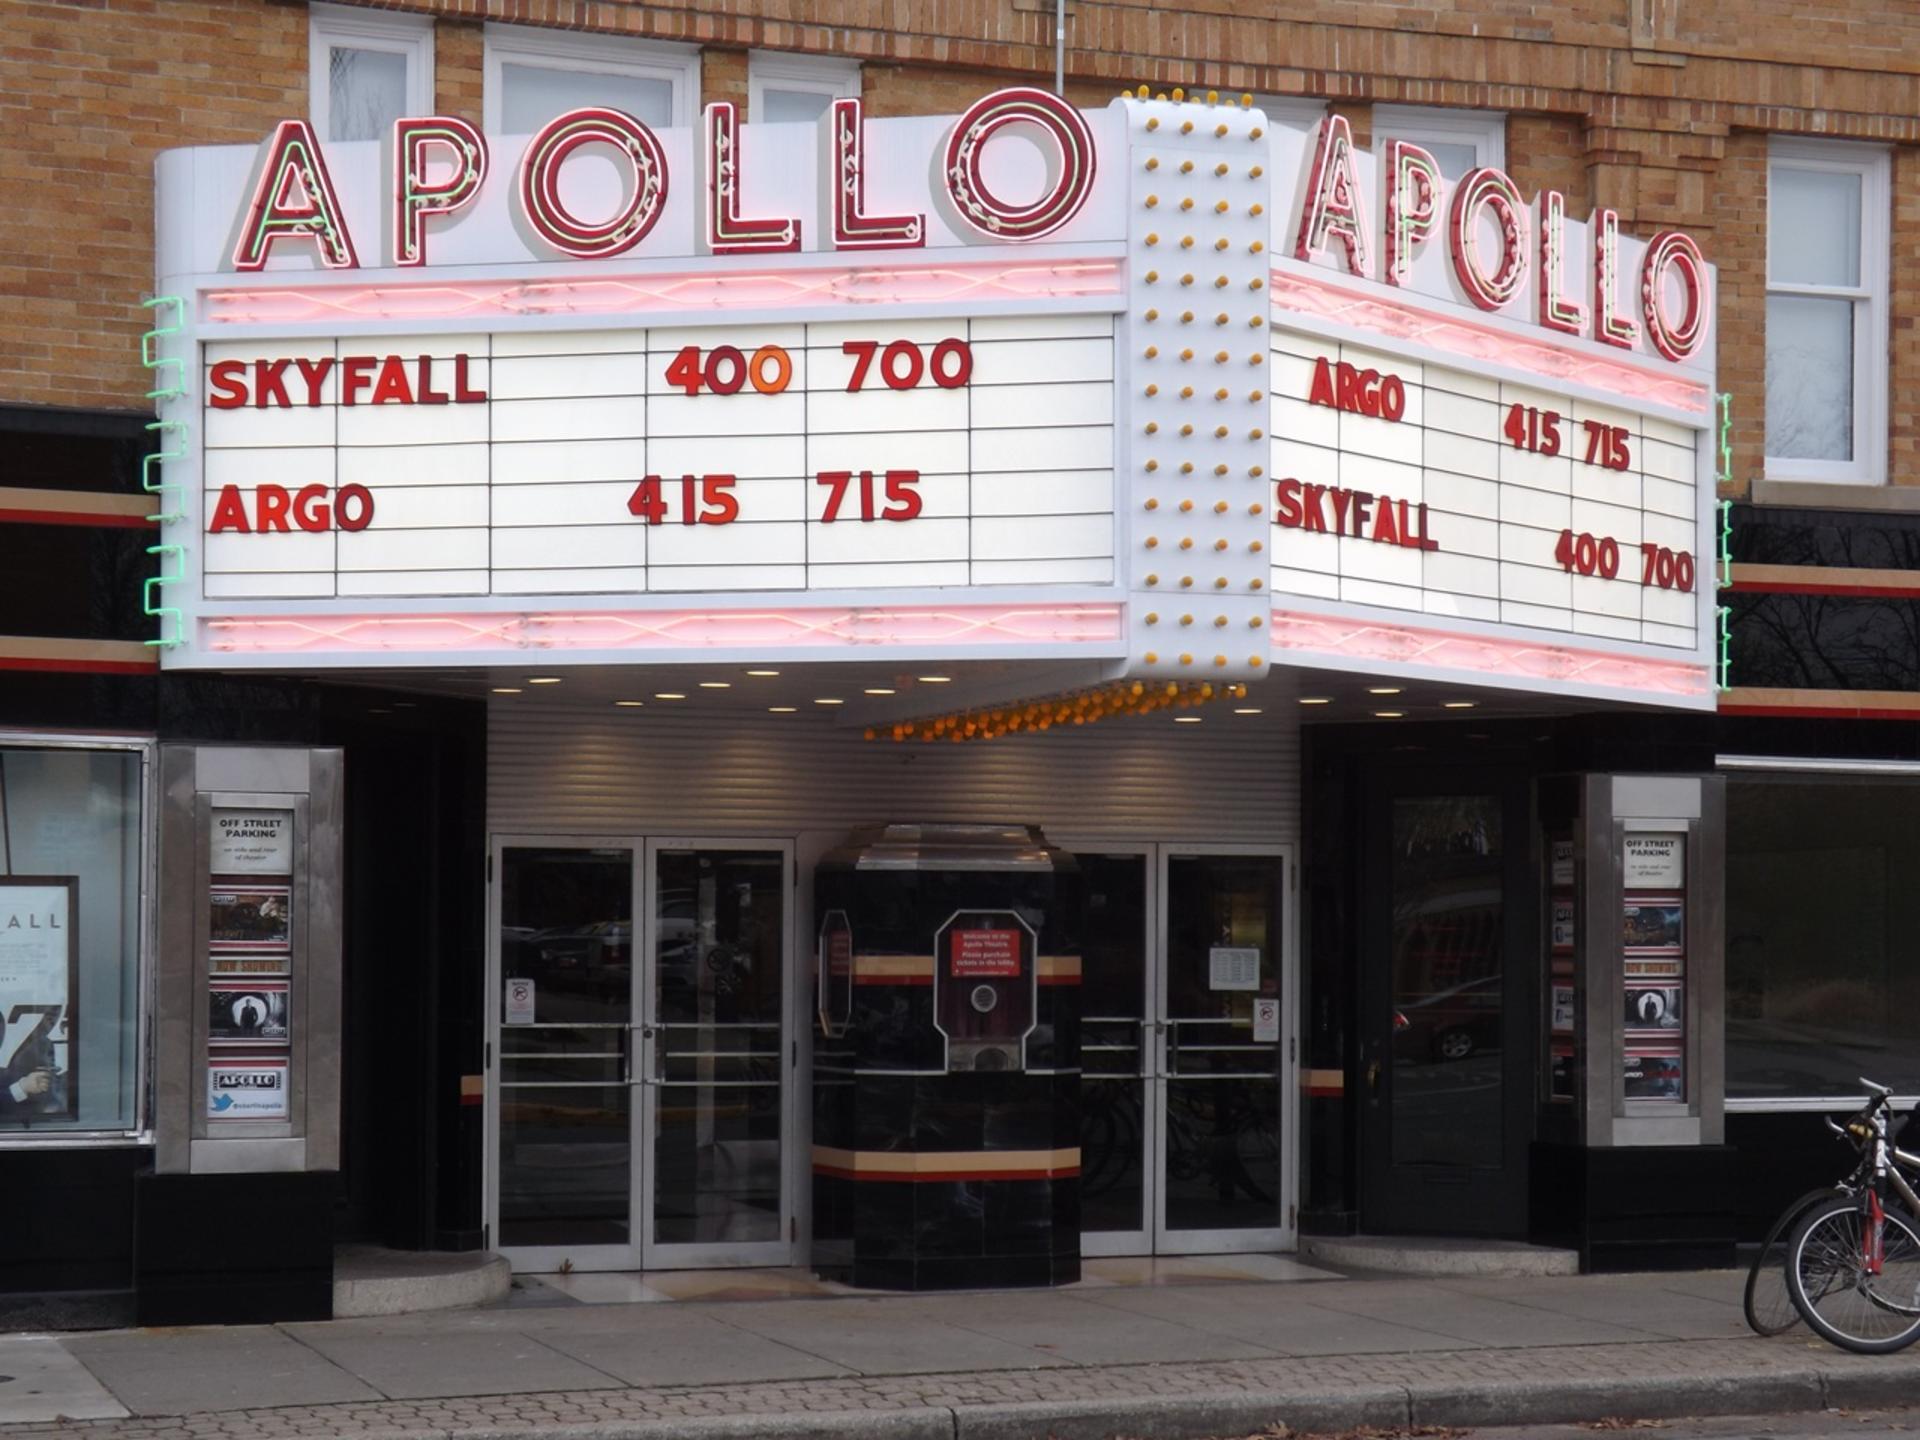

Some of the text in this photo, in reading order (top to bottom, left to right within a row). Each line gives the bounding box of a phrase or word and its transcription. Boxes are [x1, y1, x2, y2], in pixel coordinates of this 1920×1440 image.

[232, 87, 1097, 271] APOLLO
[1293, 115, 1711, 362] APOLLO
[209, 338, 973, 410] SKYFALL 400 700
[1309, 356, 1630, 472] ARGO 415 715
[209, 470, 923, 534] ARGO 415 715
[1277, 478, 1694, 593] SKYFALL 400 700
[219, 819, 283, 828] OFF STREET
[226, 829, 277, 838] PARKING
[1626, 840, 1675, 848] OFF STREET
[1631, 849, 1671, 857] PARKING
